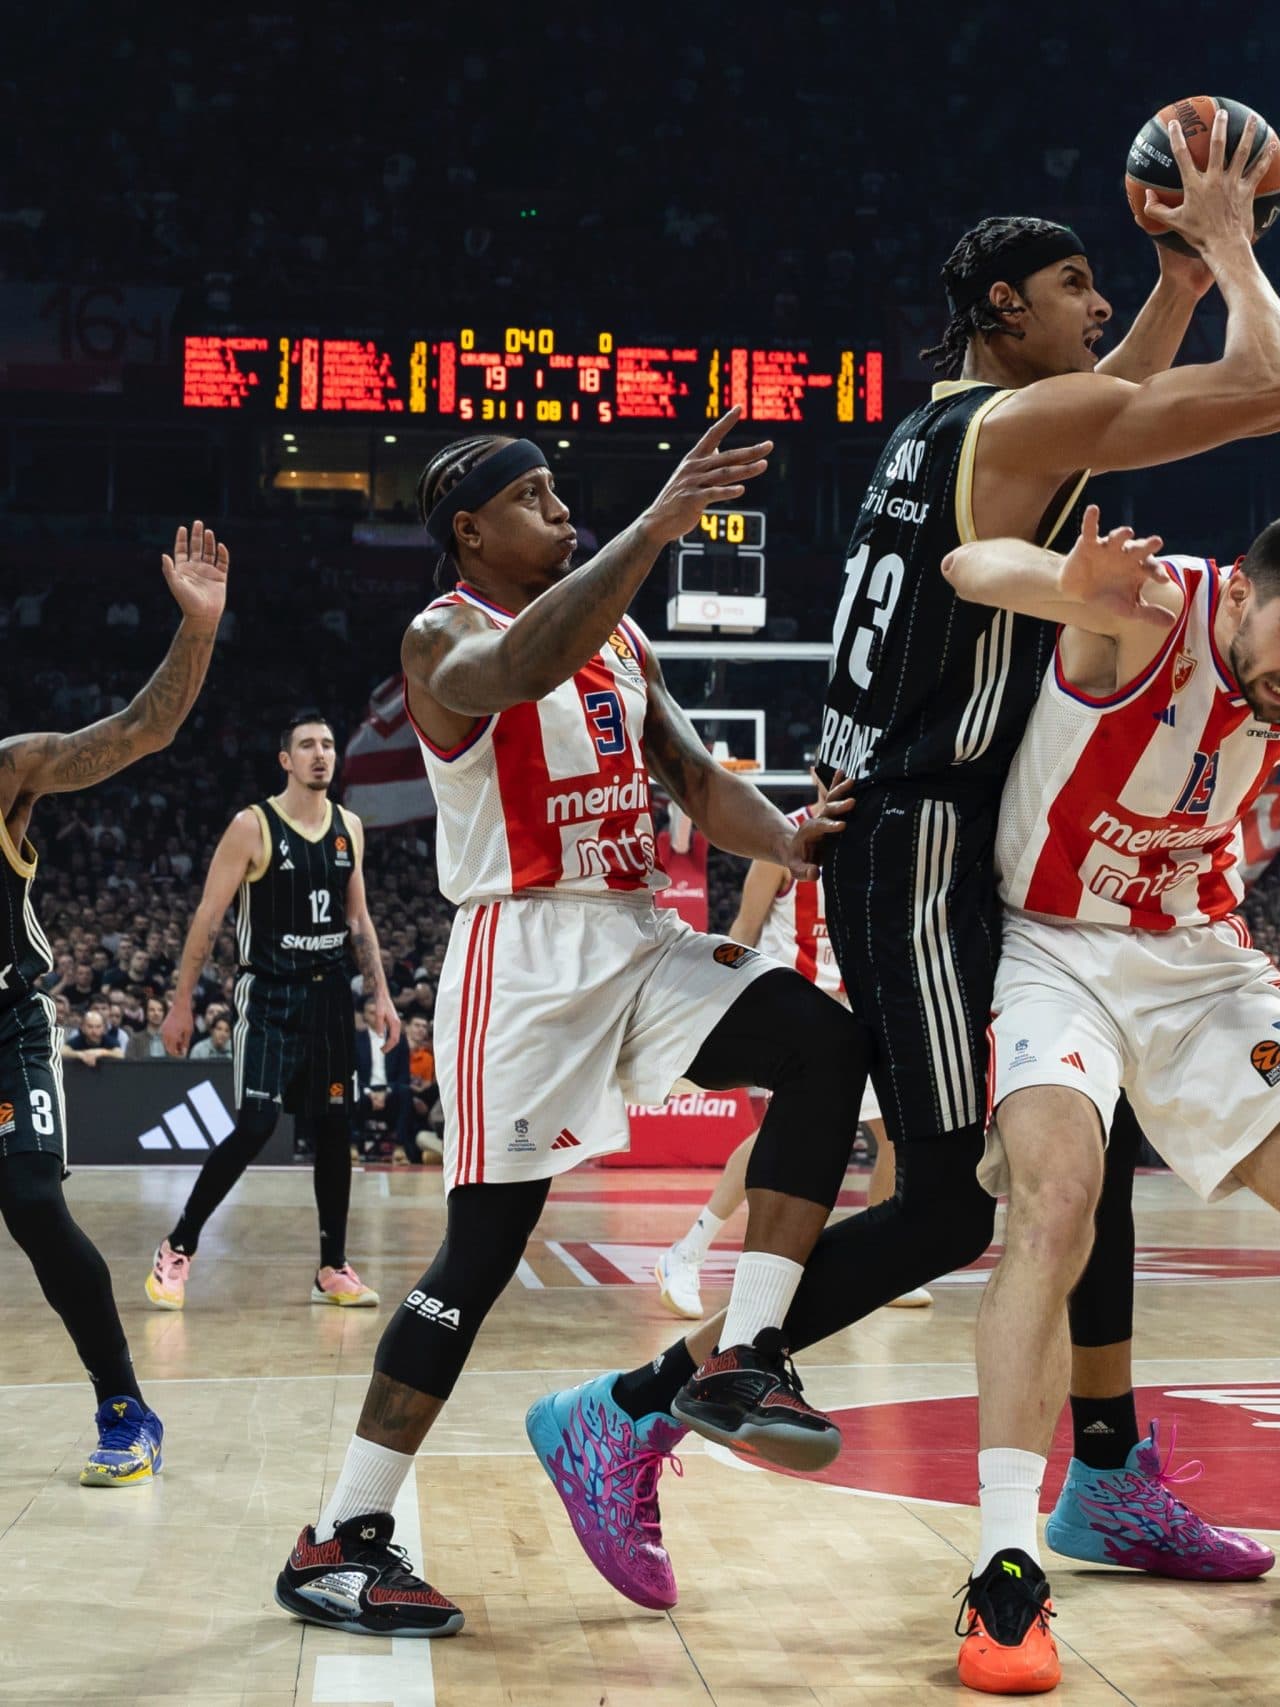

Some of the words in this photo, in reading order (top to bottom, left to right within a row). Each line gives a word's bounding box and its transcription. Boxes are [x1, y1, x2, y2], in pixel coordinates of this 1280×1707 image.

[461, 329, 474, 350] 0
[599, 333, 612, 353] 0
[486, 366, 506, 390] 19
[536, 369, 543, 389] 1
[579, 368, 600, 392] 18
[460, 398, 473, 420] 5
[516, 400, 524, 420] 1
[571, 402, 579, 420] 1
[598, 402, 612, 422] 5
[829, 543, 905, 690] 13
[583, 690, 627, 756] 3
[1173, 750, 1219, 814] 13
[1088, 811, 1226, 853] meridian
[576, 829, 657, 878] mts
[1089, 860, 1200, 902] mts
[309, 890, 331, 923] 12
[29, 1088, 54, 1135] 3
[407, 1290, 460, 1326] GSA
